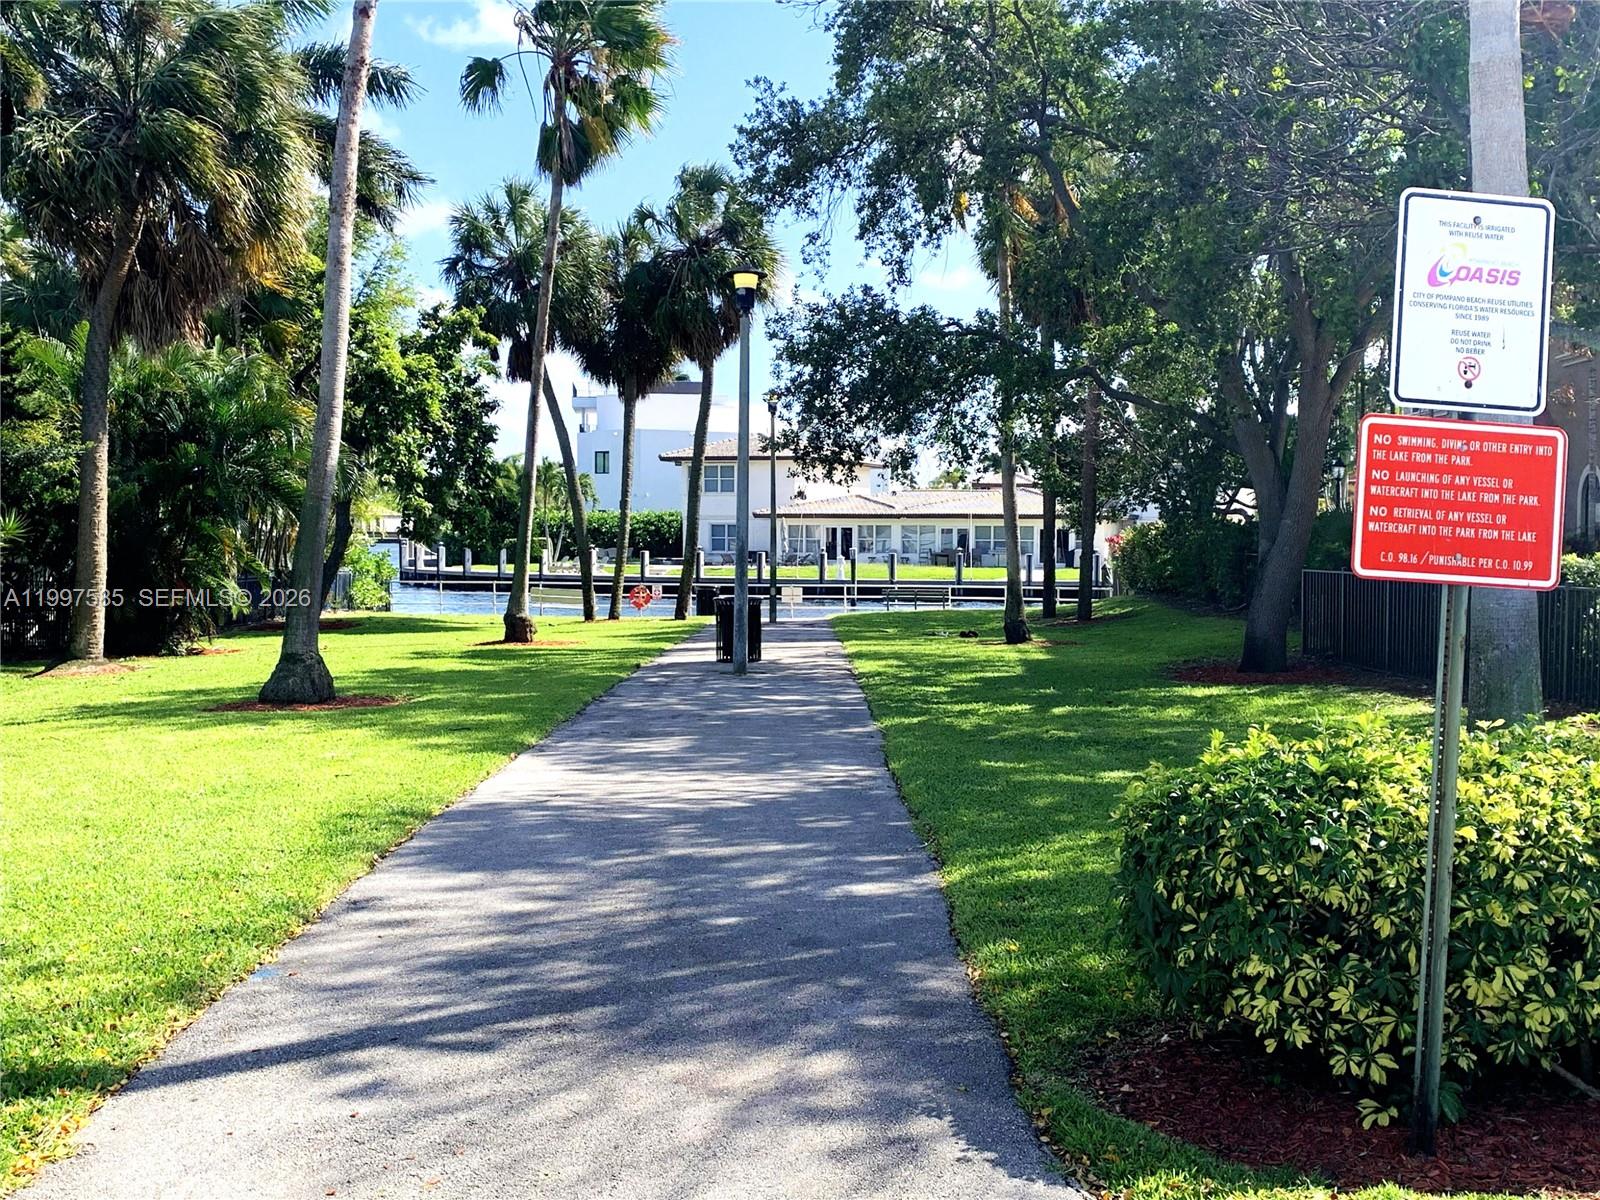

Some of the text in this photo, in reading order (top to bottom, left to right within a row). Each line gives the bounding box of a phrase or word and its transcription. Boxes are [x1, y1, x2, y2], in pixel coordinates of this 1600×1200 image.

[1439, 220, 1452, 228] THIS
[1452, 221, 1477, 230] FACILITY
[1485, 225, 1516, 233] IRRIGATED
[1464, 231, 1483, 239] REUSE
[1484, 233, 1504, 241] WATER
[1449, 265, 1521, 286] OASIS
[1426, 292, 1434, 300] OF
[1435, 294, 1466, 303] POMPANO
[1466, 296, 1486, 304] BEACH
[1487, 298, 1507, 306] REUSE
[1507, 300, 1533, 308] UTILITIES
[1409, 300, 1535, 317] CONSERVING FLORIDA'S WATER RESOURCES
[1455, 313, 1490, 322] SINCE 1989
[1451, 329, 1470, 337] REUSE
[1460, 338, 1472, 346] NOT
[1472, 339, 1491, 347] DRINK
[1465, 347, 1485, 355] BEBER
[1374, 434, 1392, 445] NO
[1470, 441, 1481, 451] OR
[1483, 442, 1507, 453] OTHER
[1510, 444, 1533, 456] ENTRY
[1536, 446, 1553, 456] INTO
[1372, 450, 1473, 466] THE LAKE FROM THE PARK.
[1372, 470, 1513, 489] NO LAUNCHING OF ANY VESSEL OR
[1370, 485, 1541, 506] WATERCRAFT INTO THE LAKE FROM THE PARK.
[1369, 506, 1507, 525] NO RETRIEVAL OF ANY VESSEL OR
[1368, 522, 1537, 543] WATERCRAFT INTO THE PARK FROM THE LAKE
[1380, 551, 1396, 563] C.O.
[1398, 553, 1418, 564] 98.16
[1479, 558, 1493, 569] PER
[1496, 559, 1511, 570] C.O.
[1513, 561, 1533, 571] 10.99
